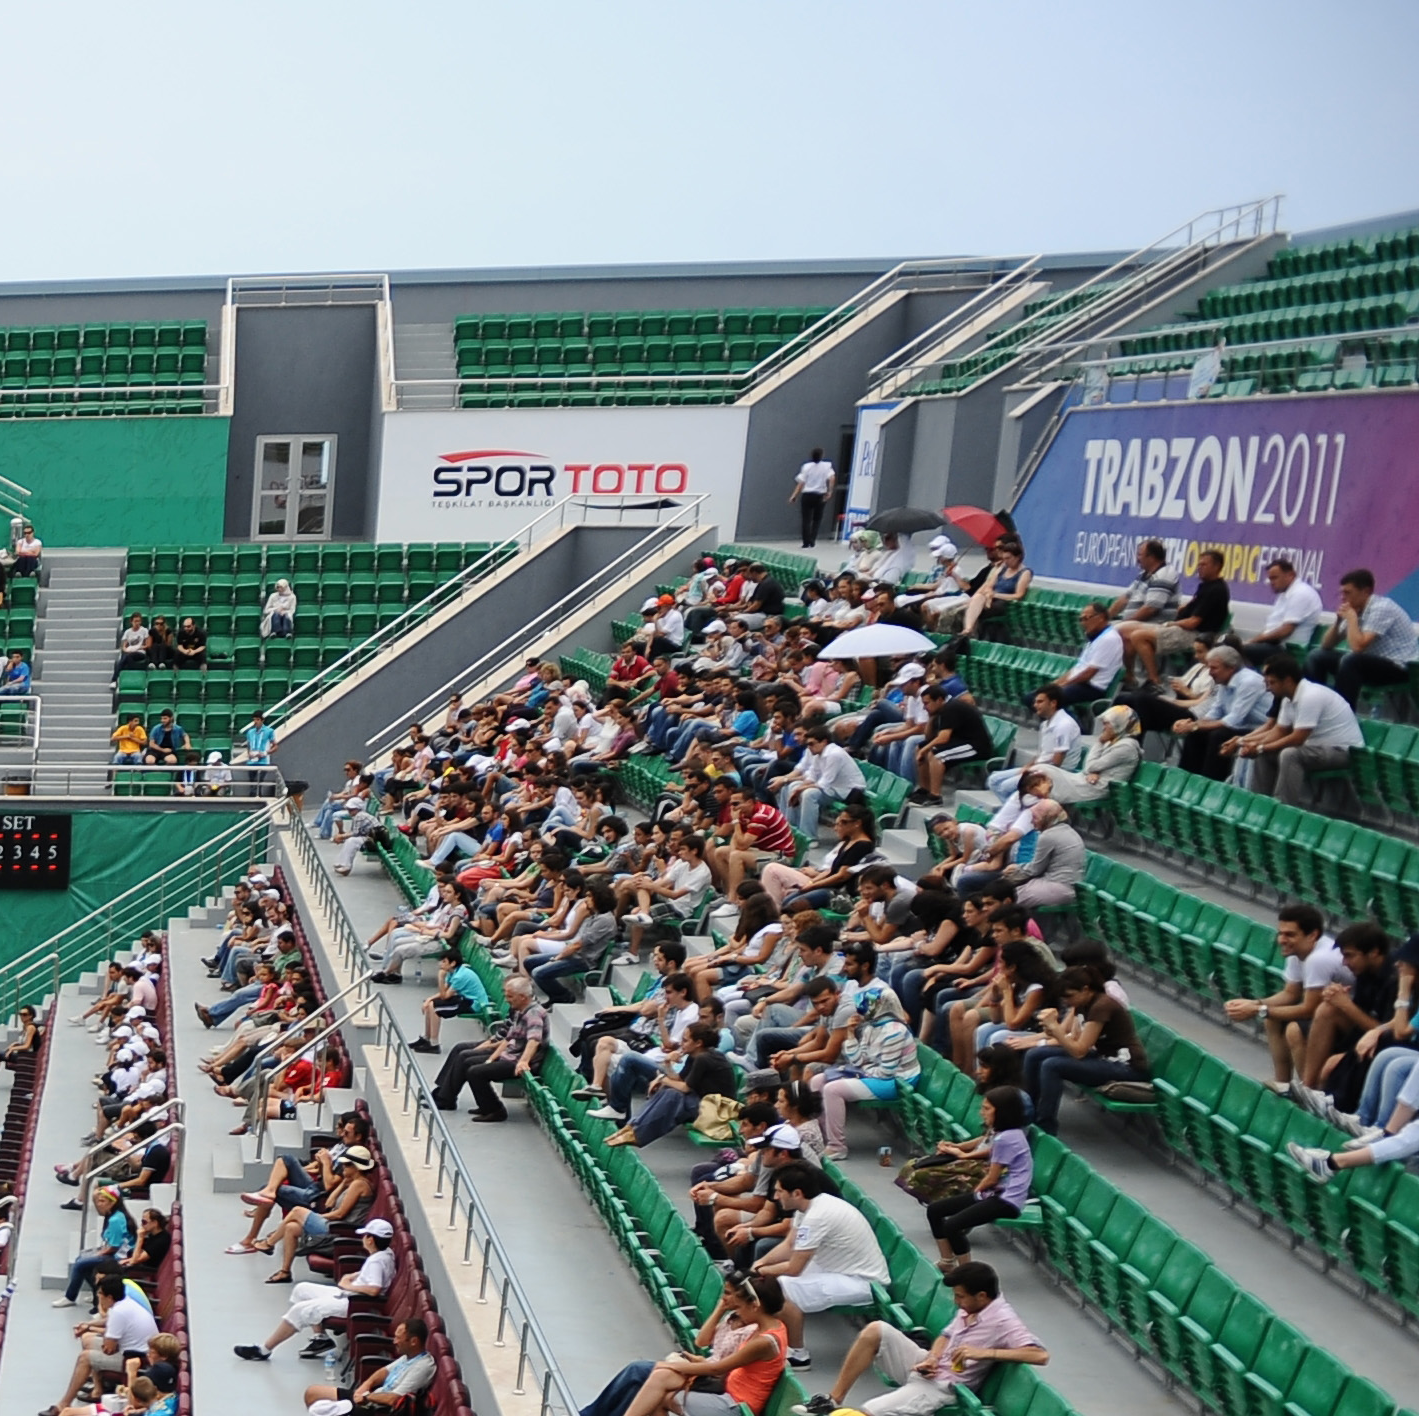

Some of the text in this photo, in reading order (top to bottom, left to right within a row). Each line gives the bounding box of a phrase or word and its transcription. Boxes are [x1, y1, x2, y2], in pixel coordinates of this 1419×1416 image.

[433, 463, 689, 497] SPOR TOTO
[3, 816, 35, 830] SET
[13, 846, 22, 860] 3
[29, 845, 40, 860] 4
[48, 845, 57, 860] 5
